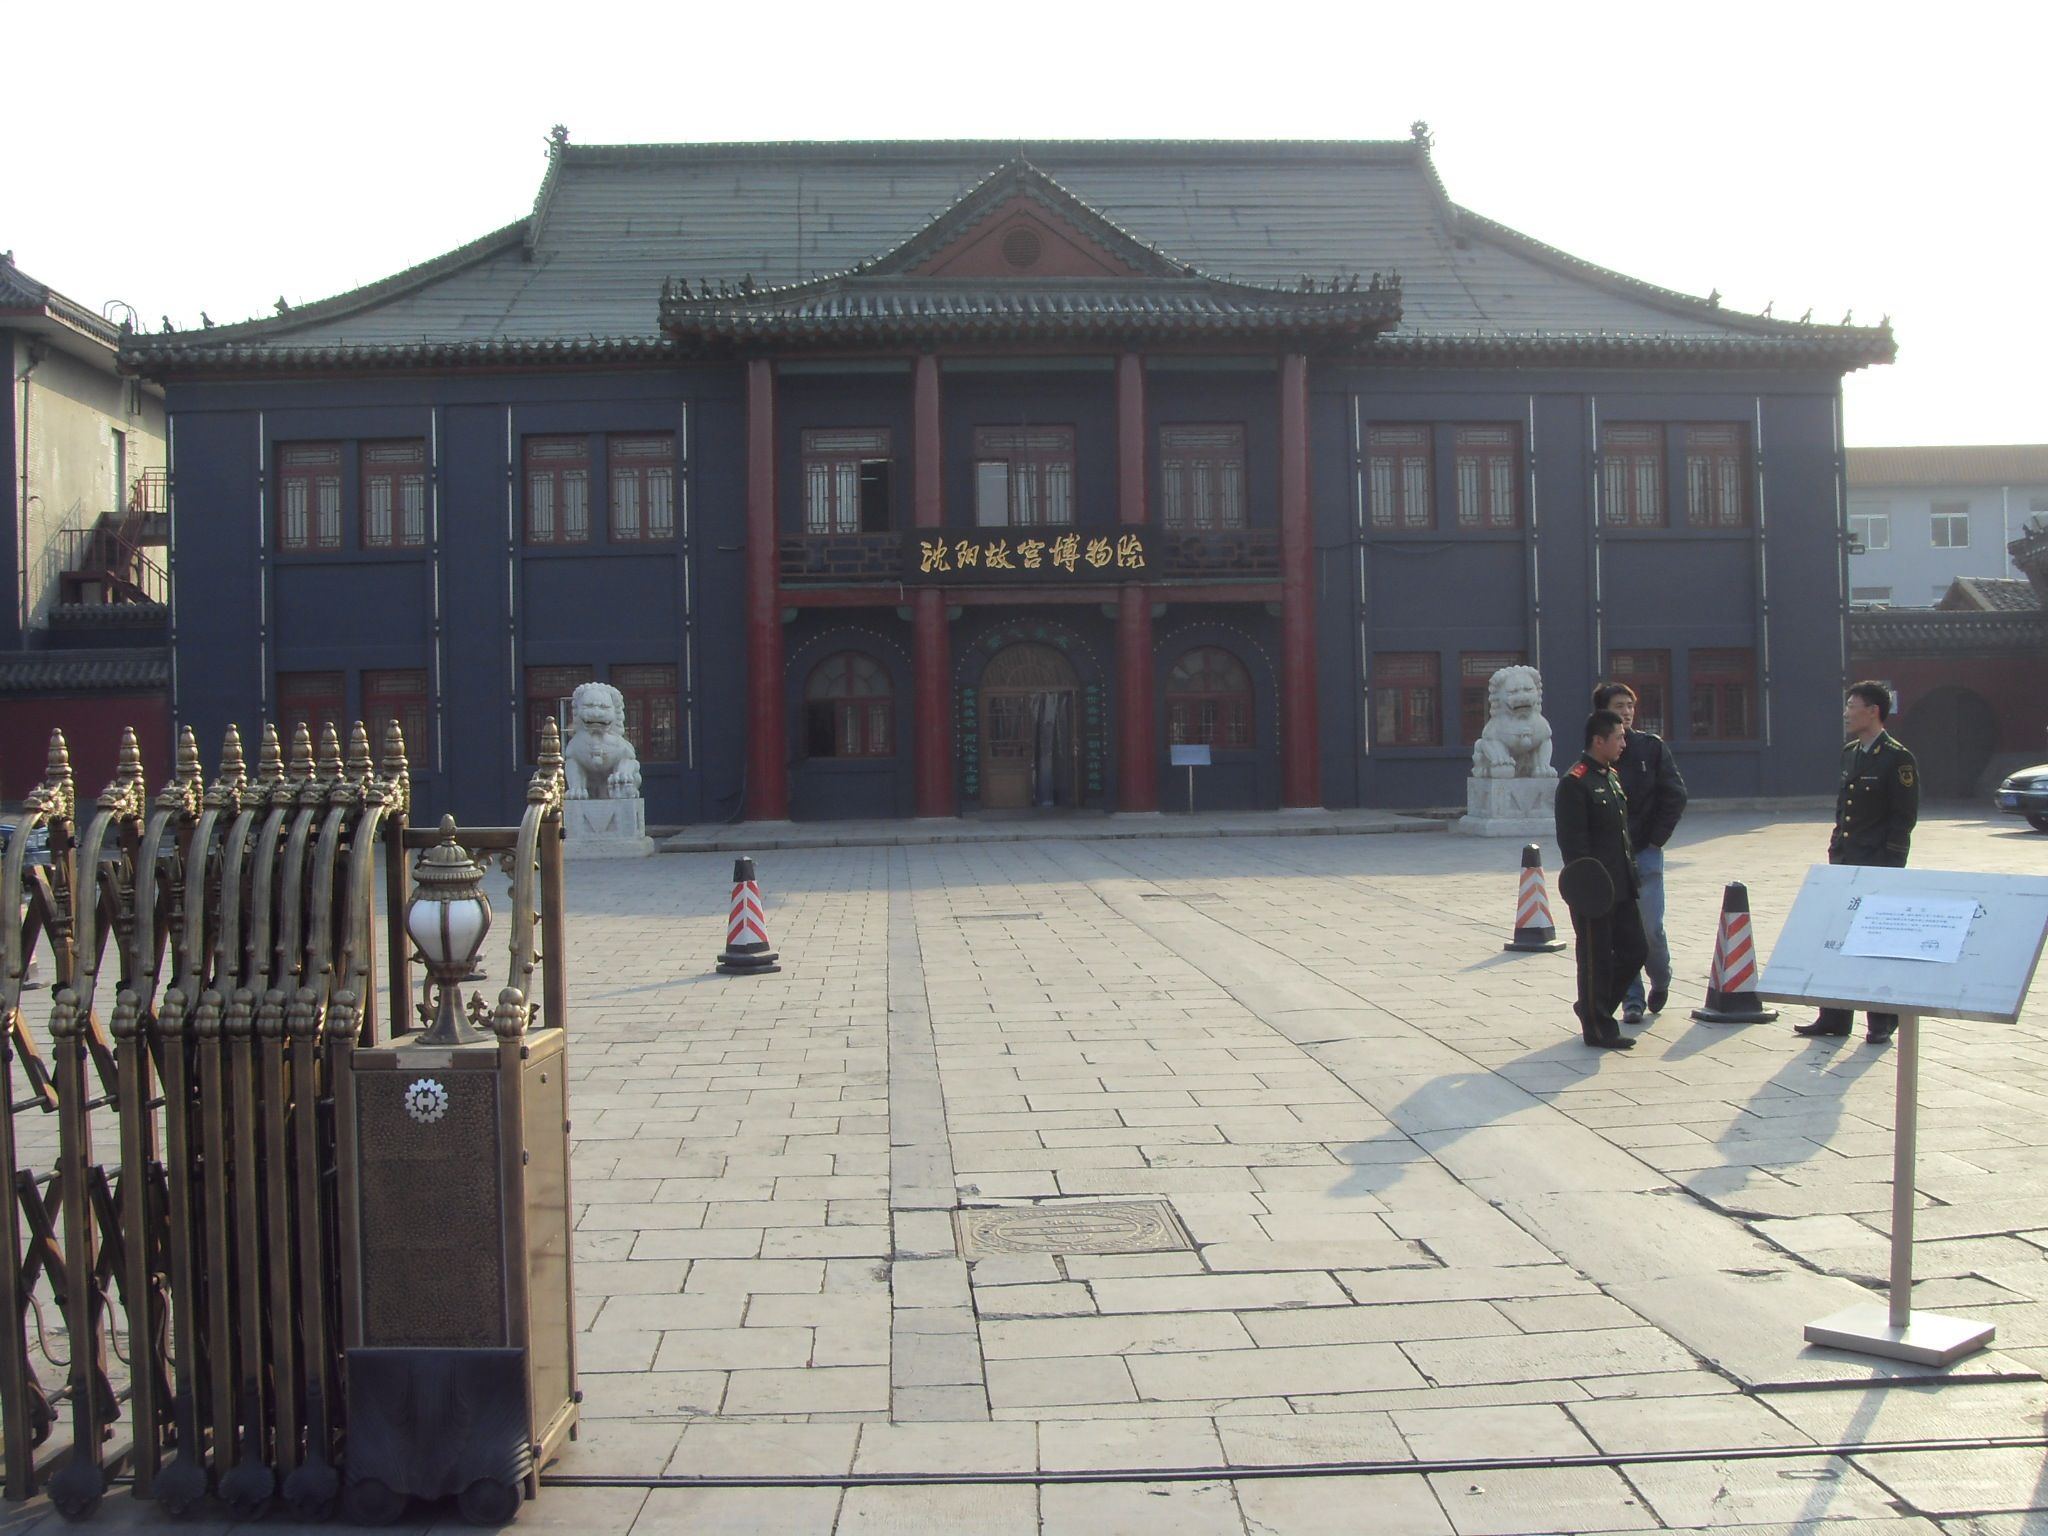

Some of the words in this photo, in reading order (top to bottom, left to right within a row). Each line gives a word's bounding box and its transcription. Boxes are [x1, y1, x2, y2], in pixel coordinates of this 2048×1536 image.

[919, 533, 1146, 573] 沈阳故宫博物院
